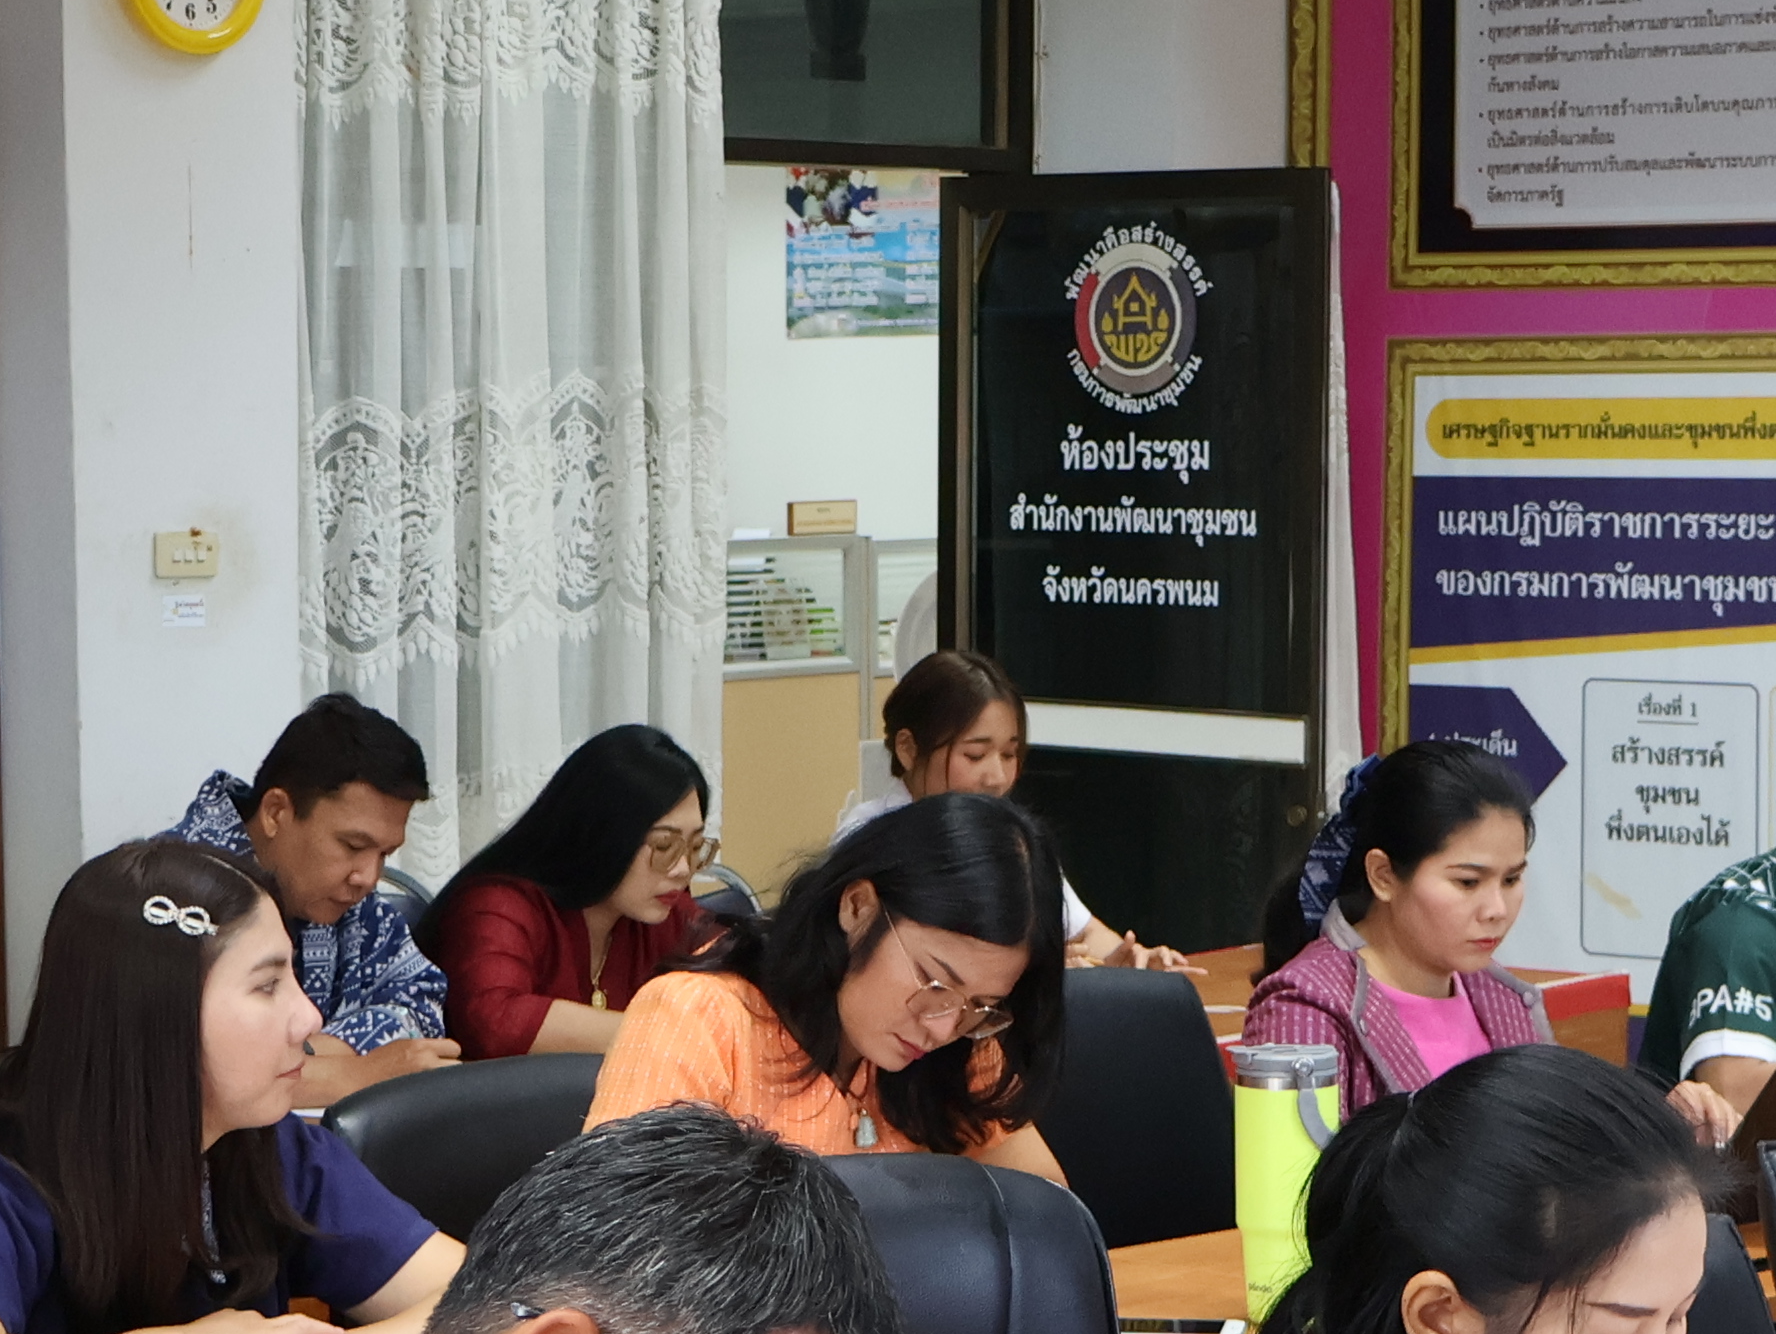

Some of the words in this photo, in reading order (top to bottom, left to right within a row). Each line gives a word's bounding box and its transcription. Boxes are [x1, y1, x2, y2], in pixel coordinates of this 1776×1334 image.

[185, 3, 196, 21] 6
[1060, 424, 1211, 484] ห้องประชุม
[1008, 495, 1258, 548] สำนักงานพัฒนาชุมชน
[1437, 500, 1775, 547] แผนปฏิบัติราชการระยะ
[1042, 565, 1220, 607] จังหวัดนครพนม
[1638, 692, 1683, 717] เรื่องที่
[1689, 701, 1698, 717] 1
[1612, 736, 1726, 769] สร้างสรรค์
[1635, 783, 1700, 815] ชุมชน
[1605, 808, 1731, 848] พึ่งตนเองได้
